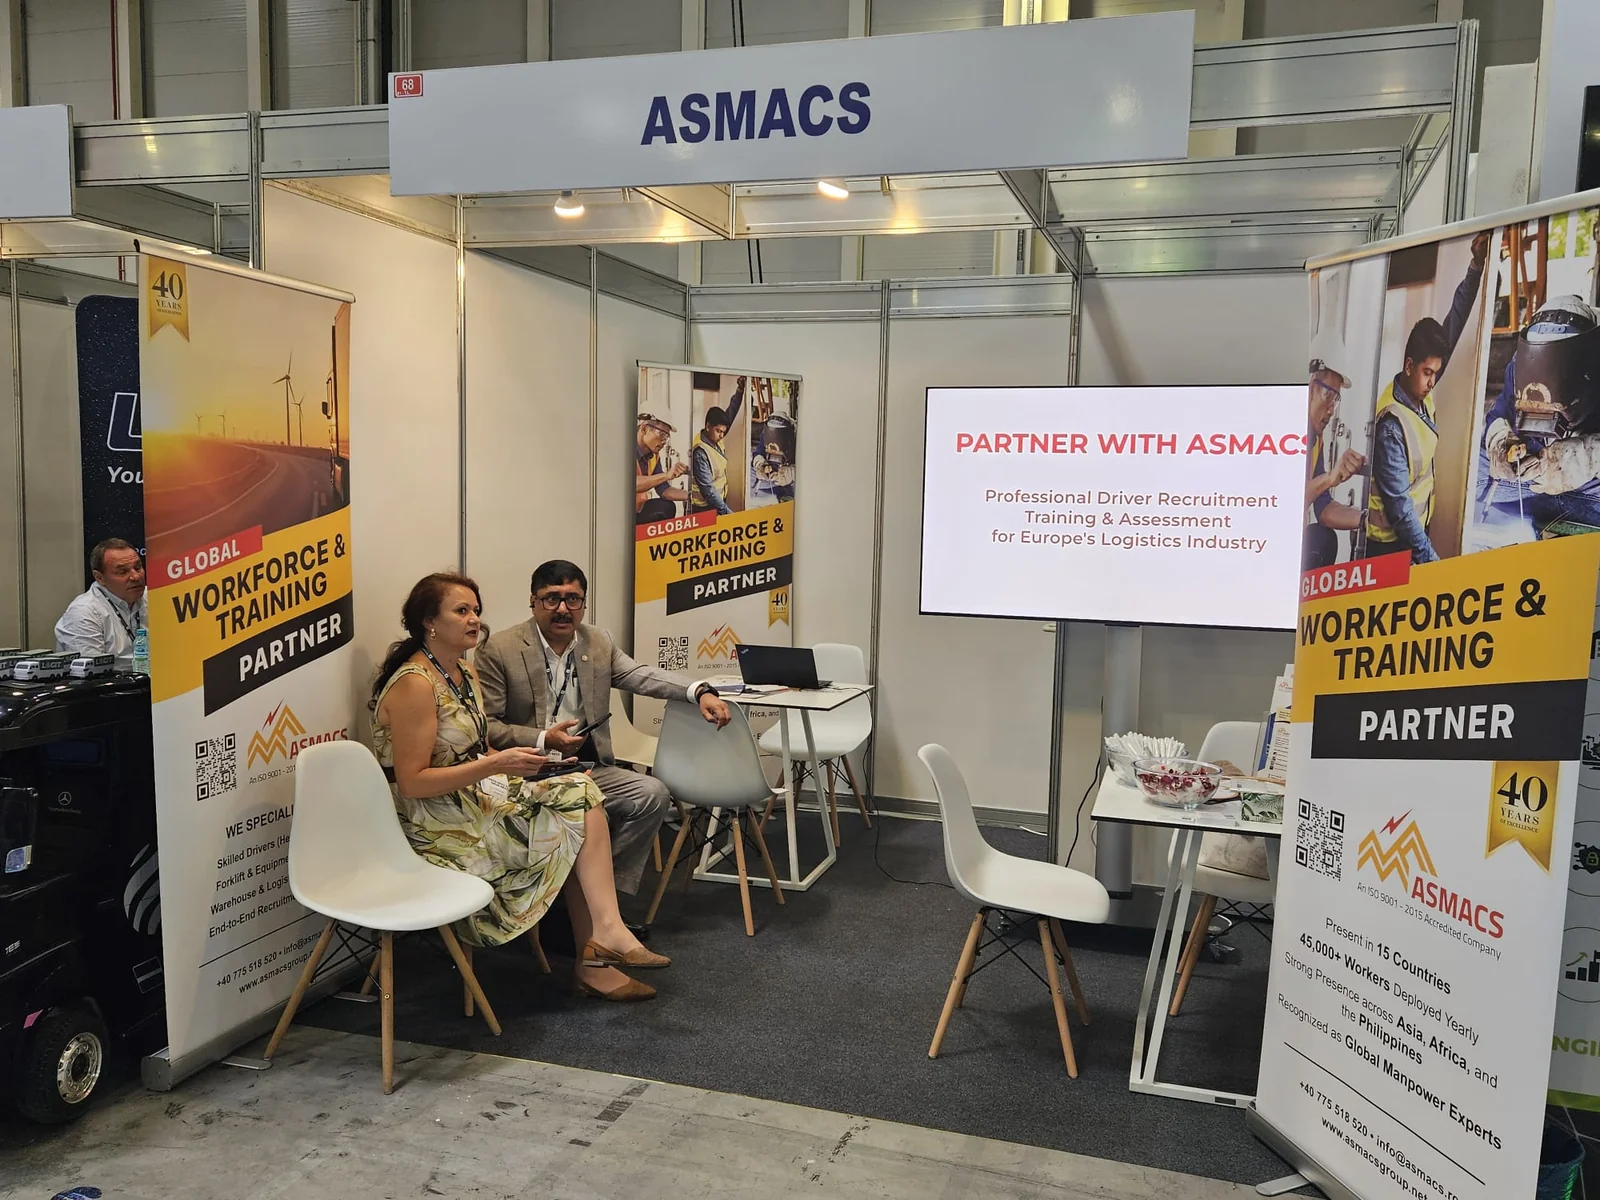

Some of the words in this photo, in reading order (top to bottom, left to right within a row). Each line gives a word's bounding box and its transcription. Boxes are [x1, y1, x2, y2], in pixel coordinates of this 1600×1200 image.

[402, 79, 414, 90] 68
[641, 82, 871, 145] ASMACS
[152, 270, 183, 301] 40
[156, 299, 182, 310] YEARS
[956, 433, 1088, 454] PARTNER
[1098, 433, 1177, 454] WITH
[985, 489, 1092, 505] Professional
[1097, 490, 1152, 506] Driver
[1158, 492, 1278, 508] Recruitment
[647, 516, 699, 537] GLOBAL
[1025, 510, 1096, 527] Training
[1101, 512, 1114, 526] &
[1119, 512, 1231, 528] Assessment
[649, 520, 768, 561] WORKFORCE
[773, 518, 784, 533] &
[992, 529, 1015, 543] for
[1021, 529, 1096, 549] Europe's
[1101, 531, 1182, 551] Logistics
[1187, 535, 1267, 553] Industry
[167, 539, 240, 579] GLOBAL
[678, 541, 766, 574] TRAINING
[172, 538, 329, 624] WORKFORCE
[334, 533, 346, 558] &
[694, 567, 777, 600] PARTNER
[1302, 564, 1377, 597] GLOBAL
[215, 571, 328, 640] TRAINING
[772, 592, 788, 606] 40
[1301, 583, 1504, 647] WORKFORCE
[1515, 578, 1546, 617] &
[239, 612, 342, 682] PARTNER
[1333, 631, 1494, 681] TRAINING
[1359, 704, 1515, 741] PARTNER
[257, 773, 267, 783] ISO
[268, 768, 282, 780] 9001
[1497, 772, 1548, 812] 40
[225, 822, 244, 839] WE
[1501, 807, 1539, 825] YEARS
[217, 850, 245, 869] Skilled
[246, 840, 275, 858] Drivers
[216, 871, 246, 891] Forklift
[247, 867, 254, 878] &
[210, 890, 257, 915] Warehouse
[258, 884, 265, 895] &
[1411, 876, 1505, 939] ASMACS
[209, 908, 256, 938] End-to-End
[1357, 881, 1367, 894] An
[1367, 886, 1380, 899] ISO
[1380, 892, 1398, 908] 9001
[1404, 904, 1423, 921] 2015
[1424, 914, 1462, 940] Accredited
[1462, 933, 1502, 961] Company
[216, 974, 231, 987] +40
[233, 967, 247, 980] 775
[249, 958, 262, 972] 518
[264, 951, 277, 965] 520
[1326, 917, 1363, 947] Present
[1365, 936, 1374, 952] in
[1377, 943, 1390, 961] 15
[1393, 951, 1451, 995] Countries
[1300, 932, 1341, 961] 45,000+
[1344, 953, 1391, 992] Workers
[1394, 982, 1442, 1022] Deployed
[1445, 1012, 1479, 1046] Yearly
[1284, 951, 1313, 980] Strong
[1315, 968, 1360, 1003] Presence
[1362, 997, 1394, 1024] across
[1396, 1016, 1426, 1046] Asia,
[1429, 1036, 1470, 1075] Africa,
[1474, 1067, 1498, 1089] and
[1341, 1004, 1356, 1022] the
[1359, 1013, 1423, 1065] Philippines
[1278, 993, 1328, 1034] Recognized
[1330, 1030, 1342, 1043] as
[1345, 1034, 1380, 1068] Global
[1383, 1058, 1446, 1112] Manpower
[1450, 1102, 1502, 1150] Experts
[1300, 1080, 1314, 1098] +40
[1317, 1091, 1332, 1110] 775
[1334, 1104, 1350, 1123] 518
[1352, 1117, 1368, 1137] 520
